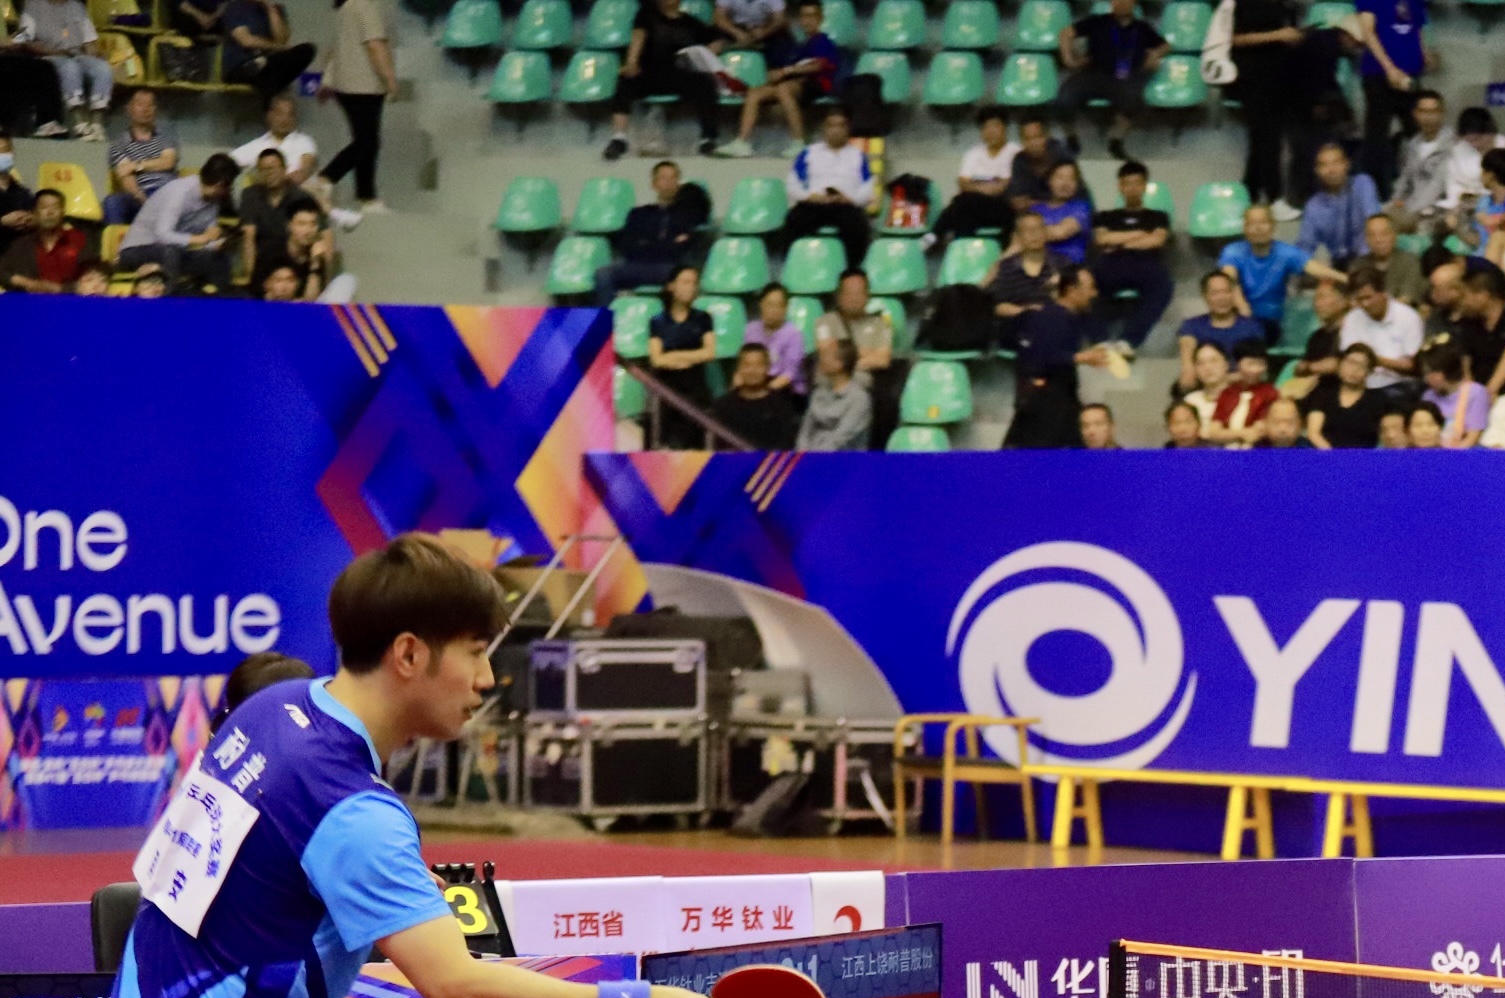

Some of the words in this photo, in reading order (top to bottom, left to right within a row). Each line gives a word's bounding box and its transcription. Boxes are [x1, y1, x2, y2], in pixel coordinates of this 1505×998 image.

[0, 494, 128, 571] ne
[444, 886, 488, 934] 3
[553, 911, 624, 939] 江西省
[681, 905, 795, 934] 万华钛业
[841, 948, 934, 980] 江西上饶耐普股份
